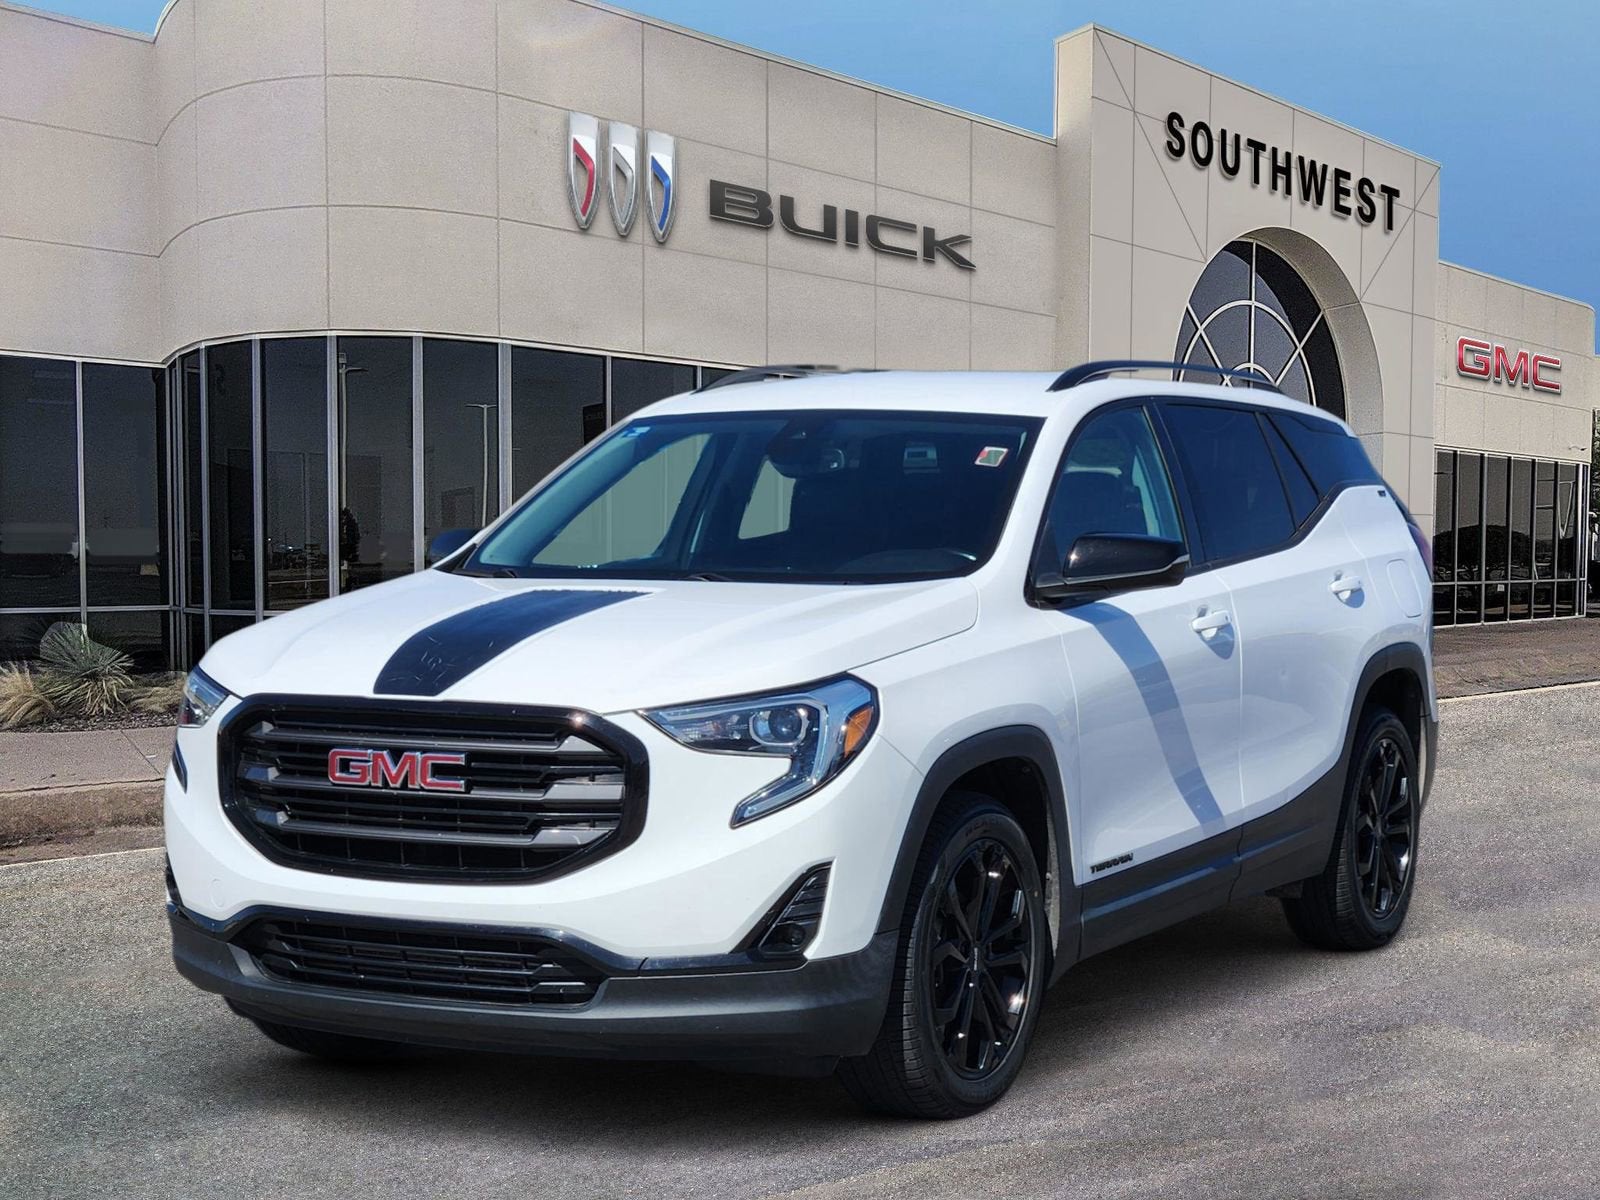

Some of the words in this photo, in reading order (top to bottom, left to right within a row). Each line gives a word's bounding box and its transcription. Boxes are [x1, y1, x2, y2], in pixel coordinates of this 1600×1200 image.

[1165, 111, 1400, 232] SOUTHWEST
[709, 179, 977, 271] BUICK
[1457, 336, 1562, 394] GMC
[328, 748, 467, 793] GMC
